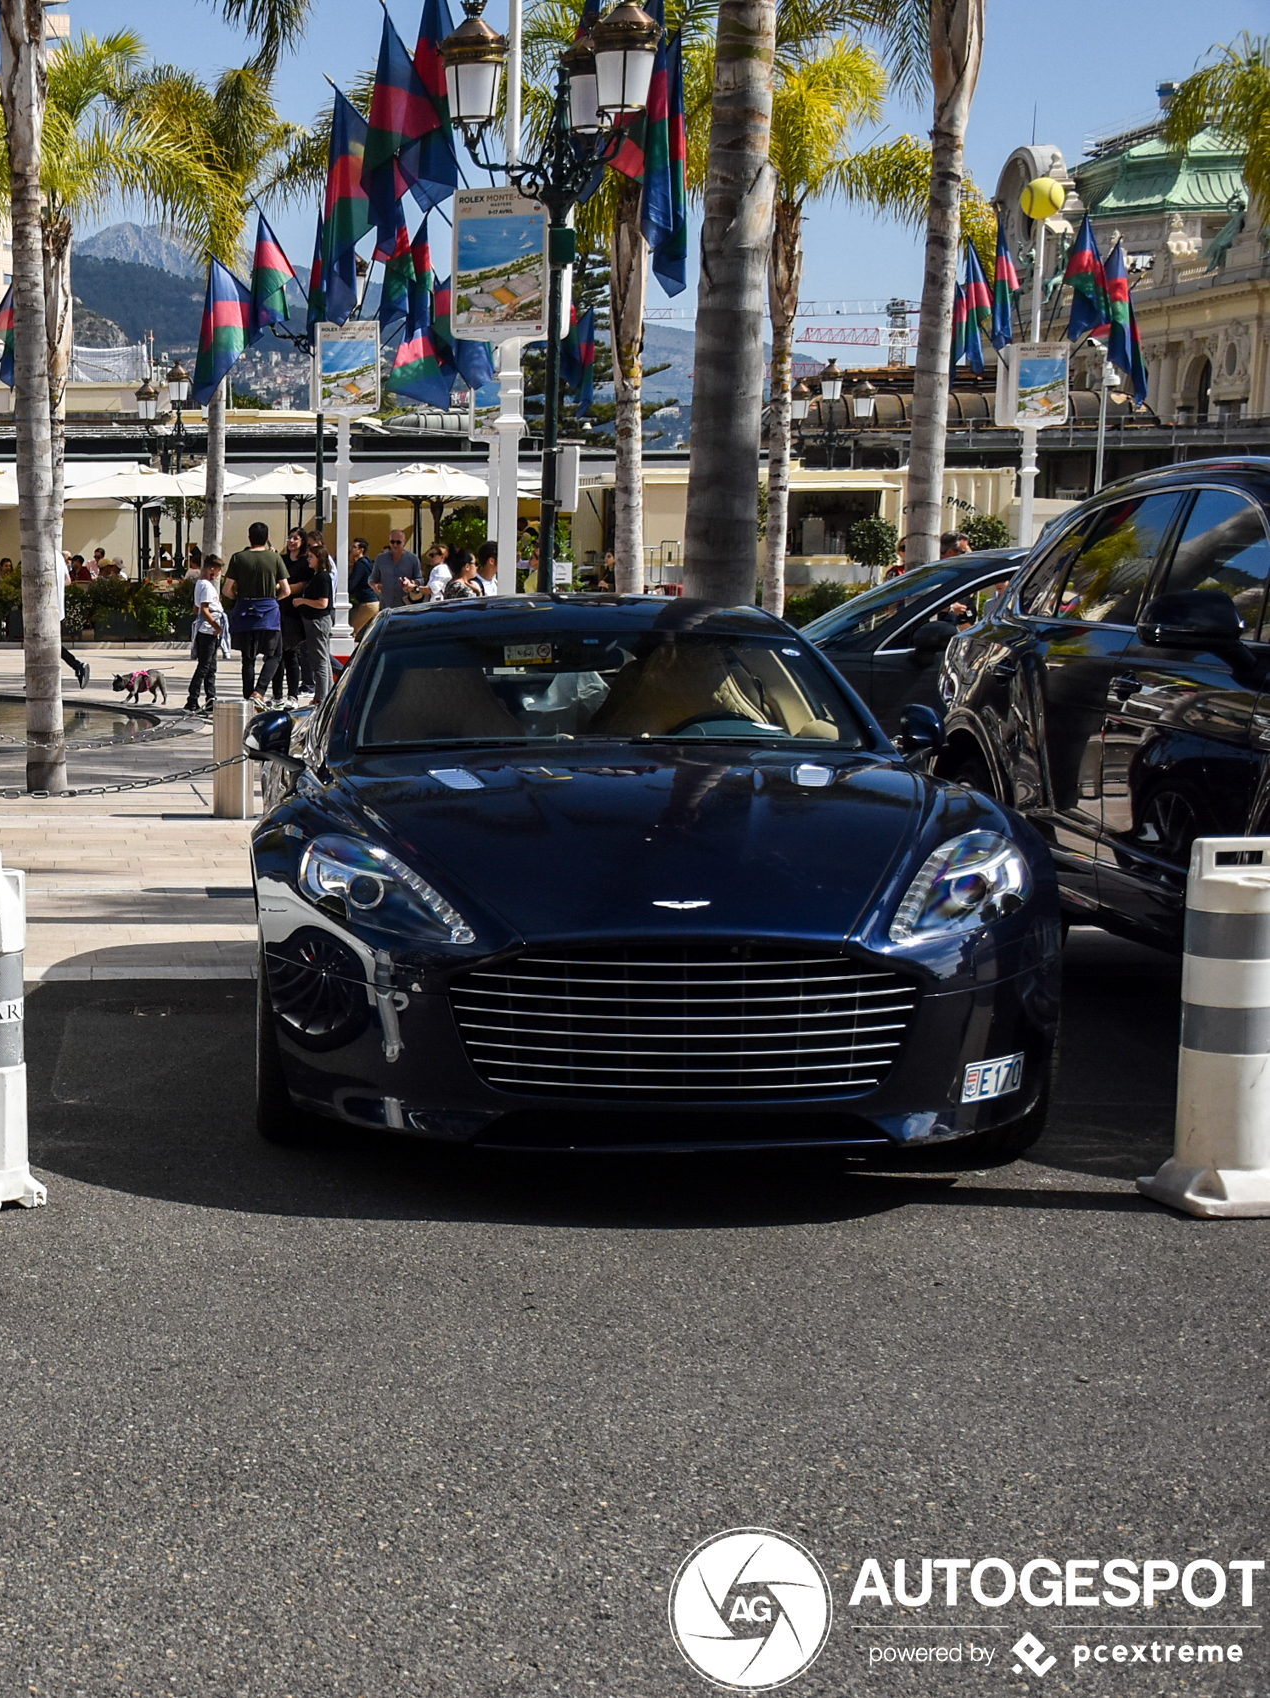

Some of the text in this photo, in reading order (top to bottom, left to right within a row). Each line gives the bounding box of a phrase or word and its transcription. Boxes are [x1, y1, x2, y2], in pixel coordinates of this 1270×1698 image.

[459, 193, 526, 204] ROLEX MONTE-C
[946, 496, 976, 515] PARIS
[978, 1060, 1022, 1096] E170
